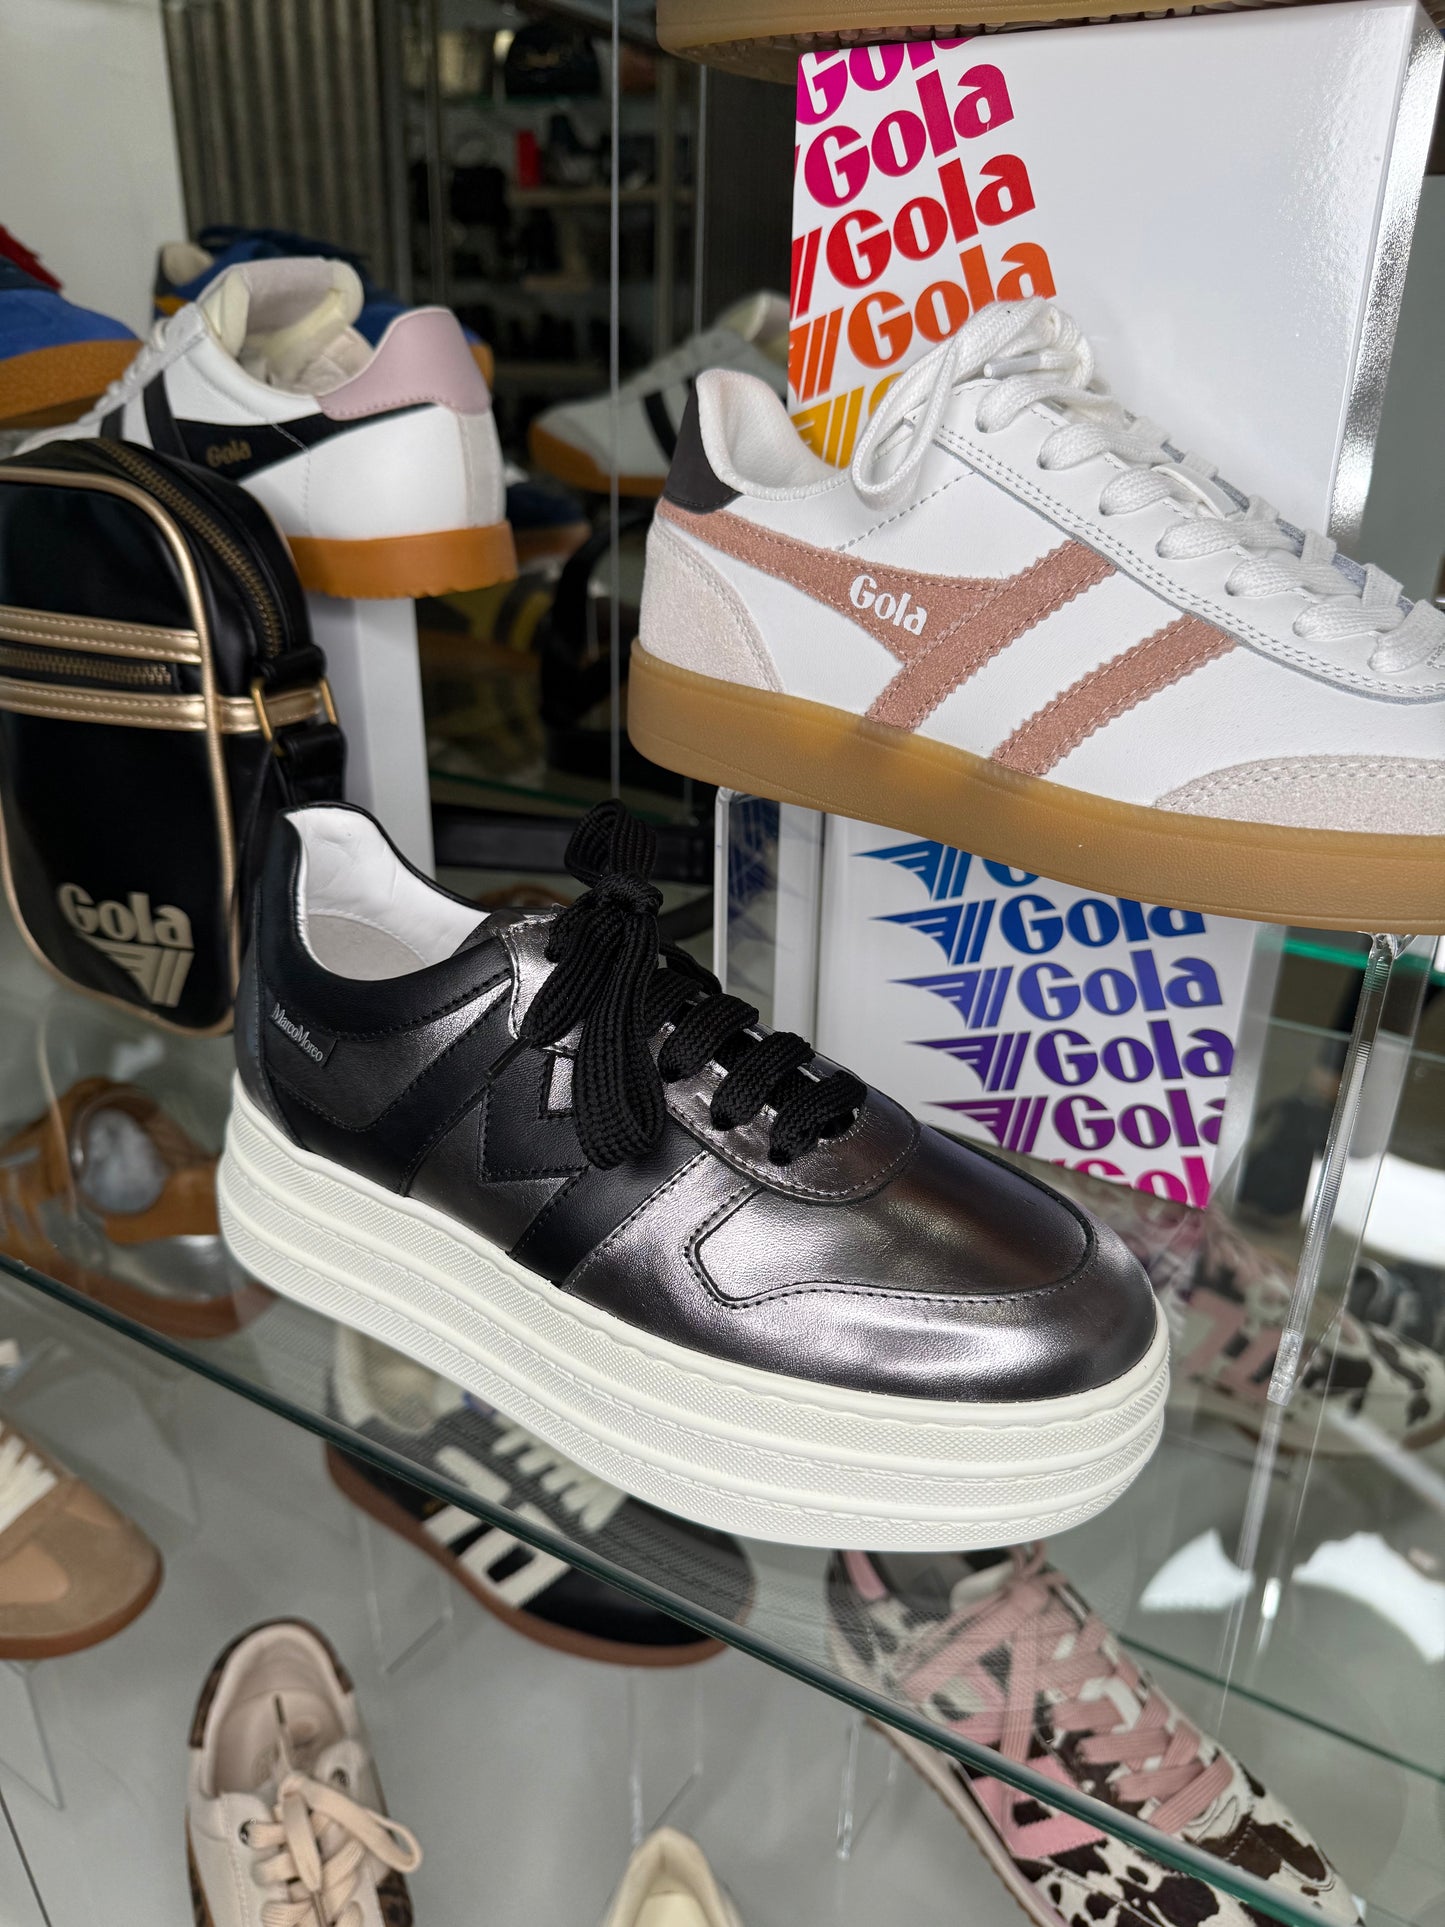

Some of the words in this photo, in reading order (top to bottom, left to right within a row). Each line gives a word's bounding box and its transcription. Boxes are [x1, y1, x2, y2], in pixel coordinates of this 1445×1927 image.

[796, 37, 976, 124] Go
[804, 64, 1014, 208] Gola
[826, 154, 1036, 289] Gola
[847, 242, 1056, 369] Gola
[849, 574, 927, 636] Gola
[58, 882, 195, 949] Gola
[1017, 950, 1223, 1021] Gola
[1035, 1020, 1234, 1087] Gola
